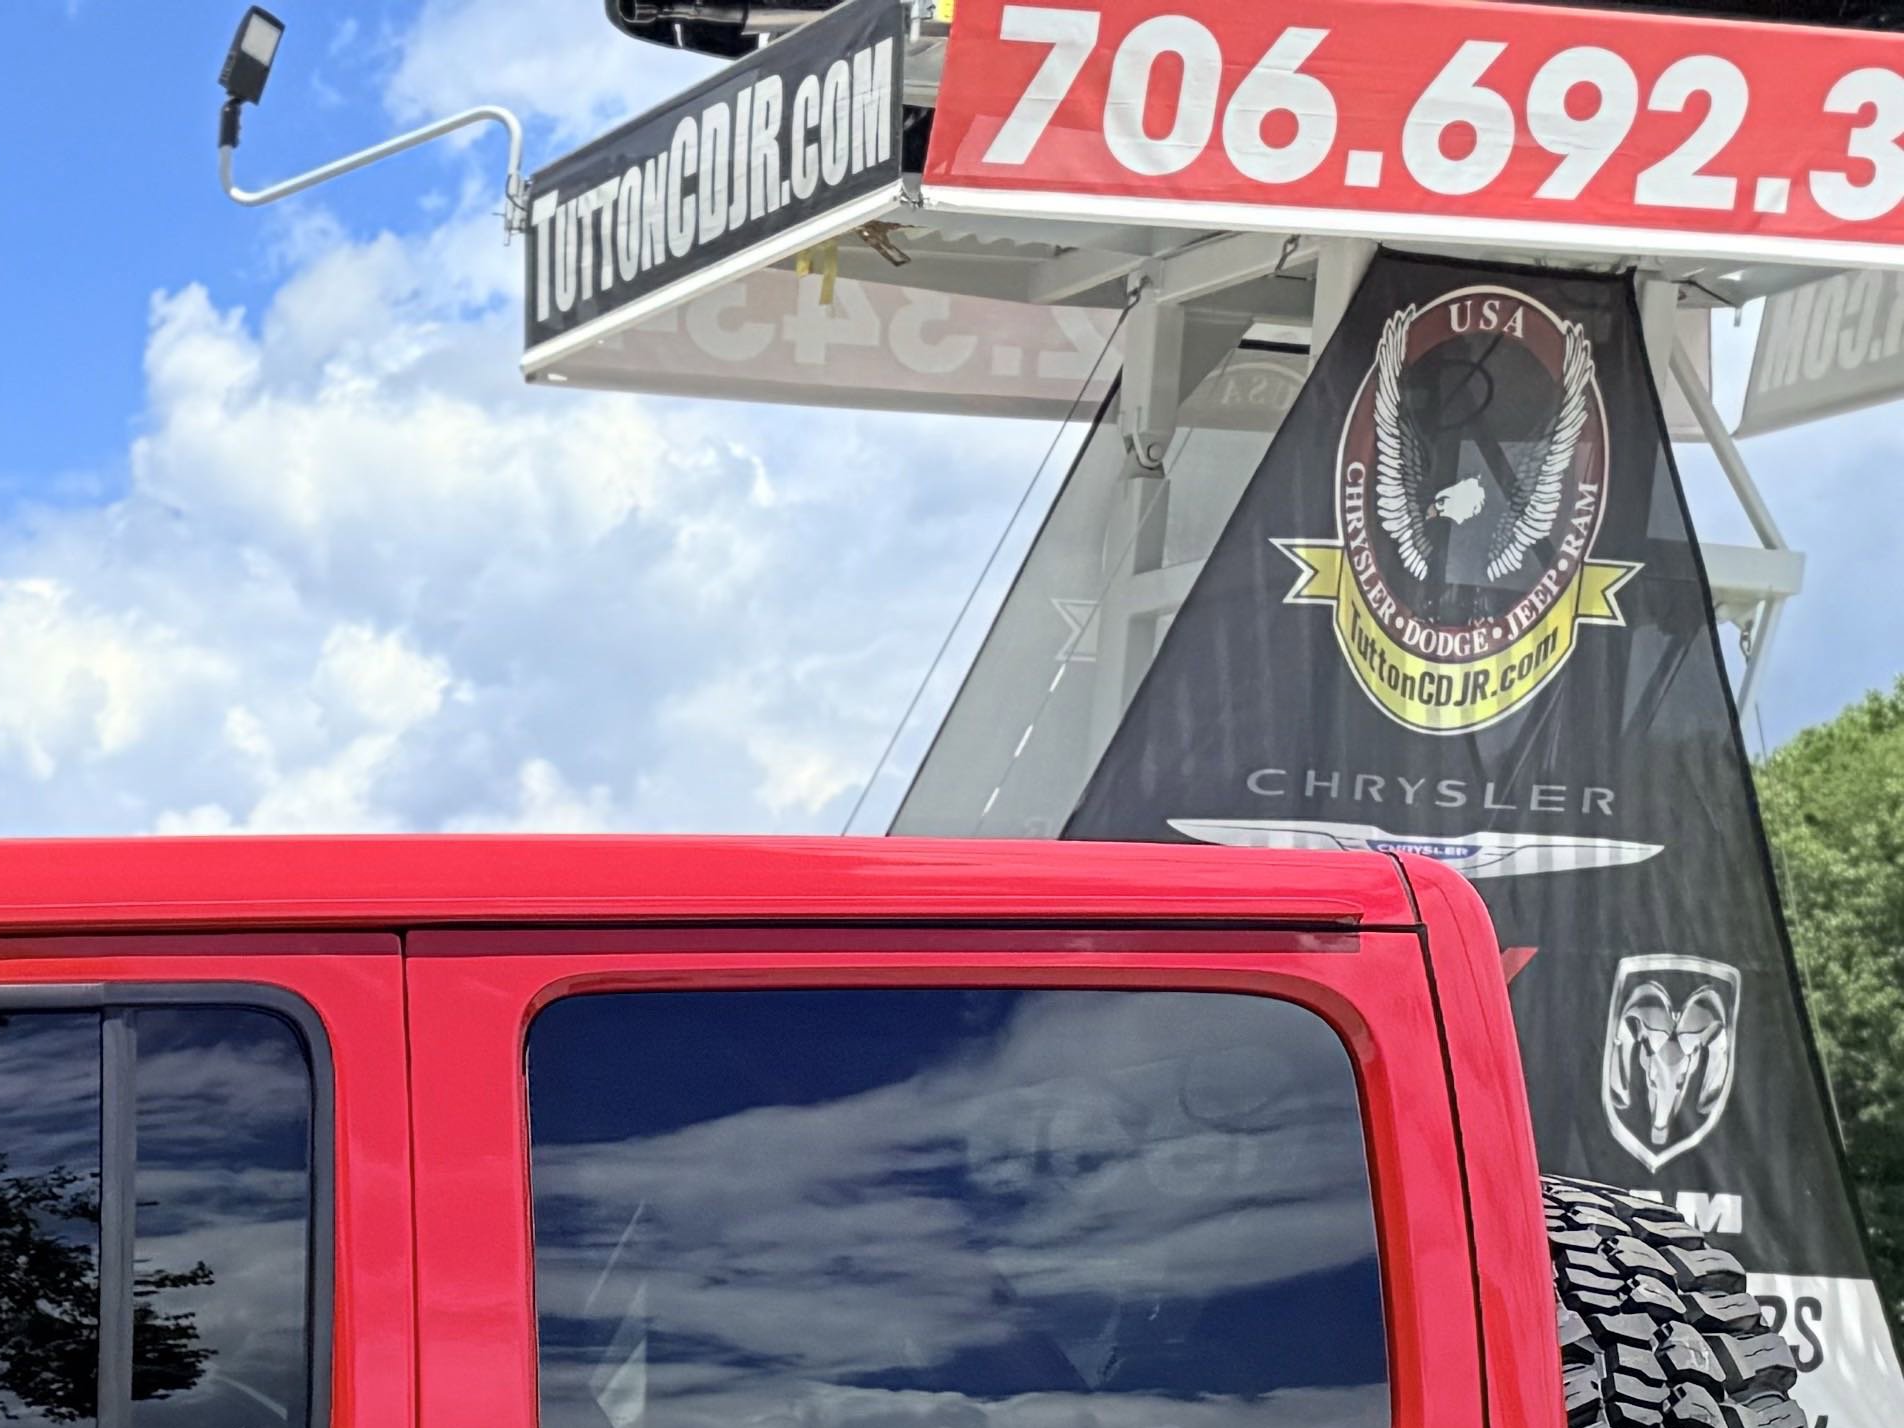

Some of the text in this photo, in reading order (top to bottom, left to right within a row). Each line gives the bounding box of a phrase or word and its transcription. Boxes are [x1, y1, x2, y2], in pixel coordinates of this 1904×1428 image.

[982, 6, 1904, 223] 706.692.3
[1449, 300, 1527, 338] USA
[1345, 461, 1599, 657] CHRYSLER DODGE JEEP RAM
[1246, 768, 1617, 816] CHRYSLER
